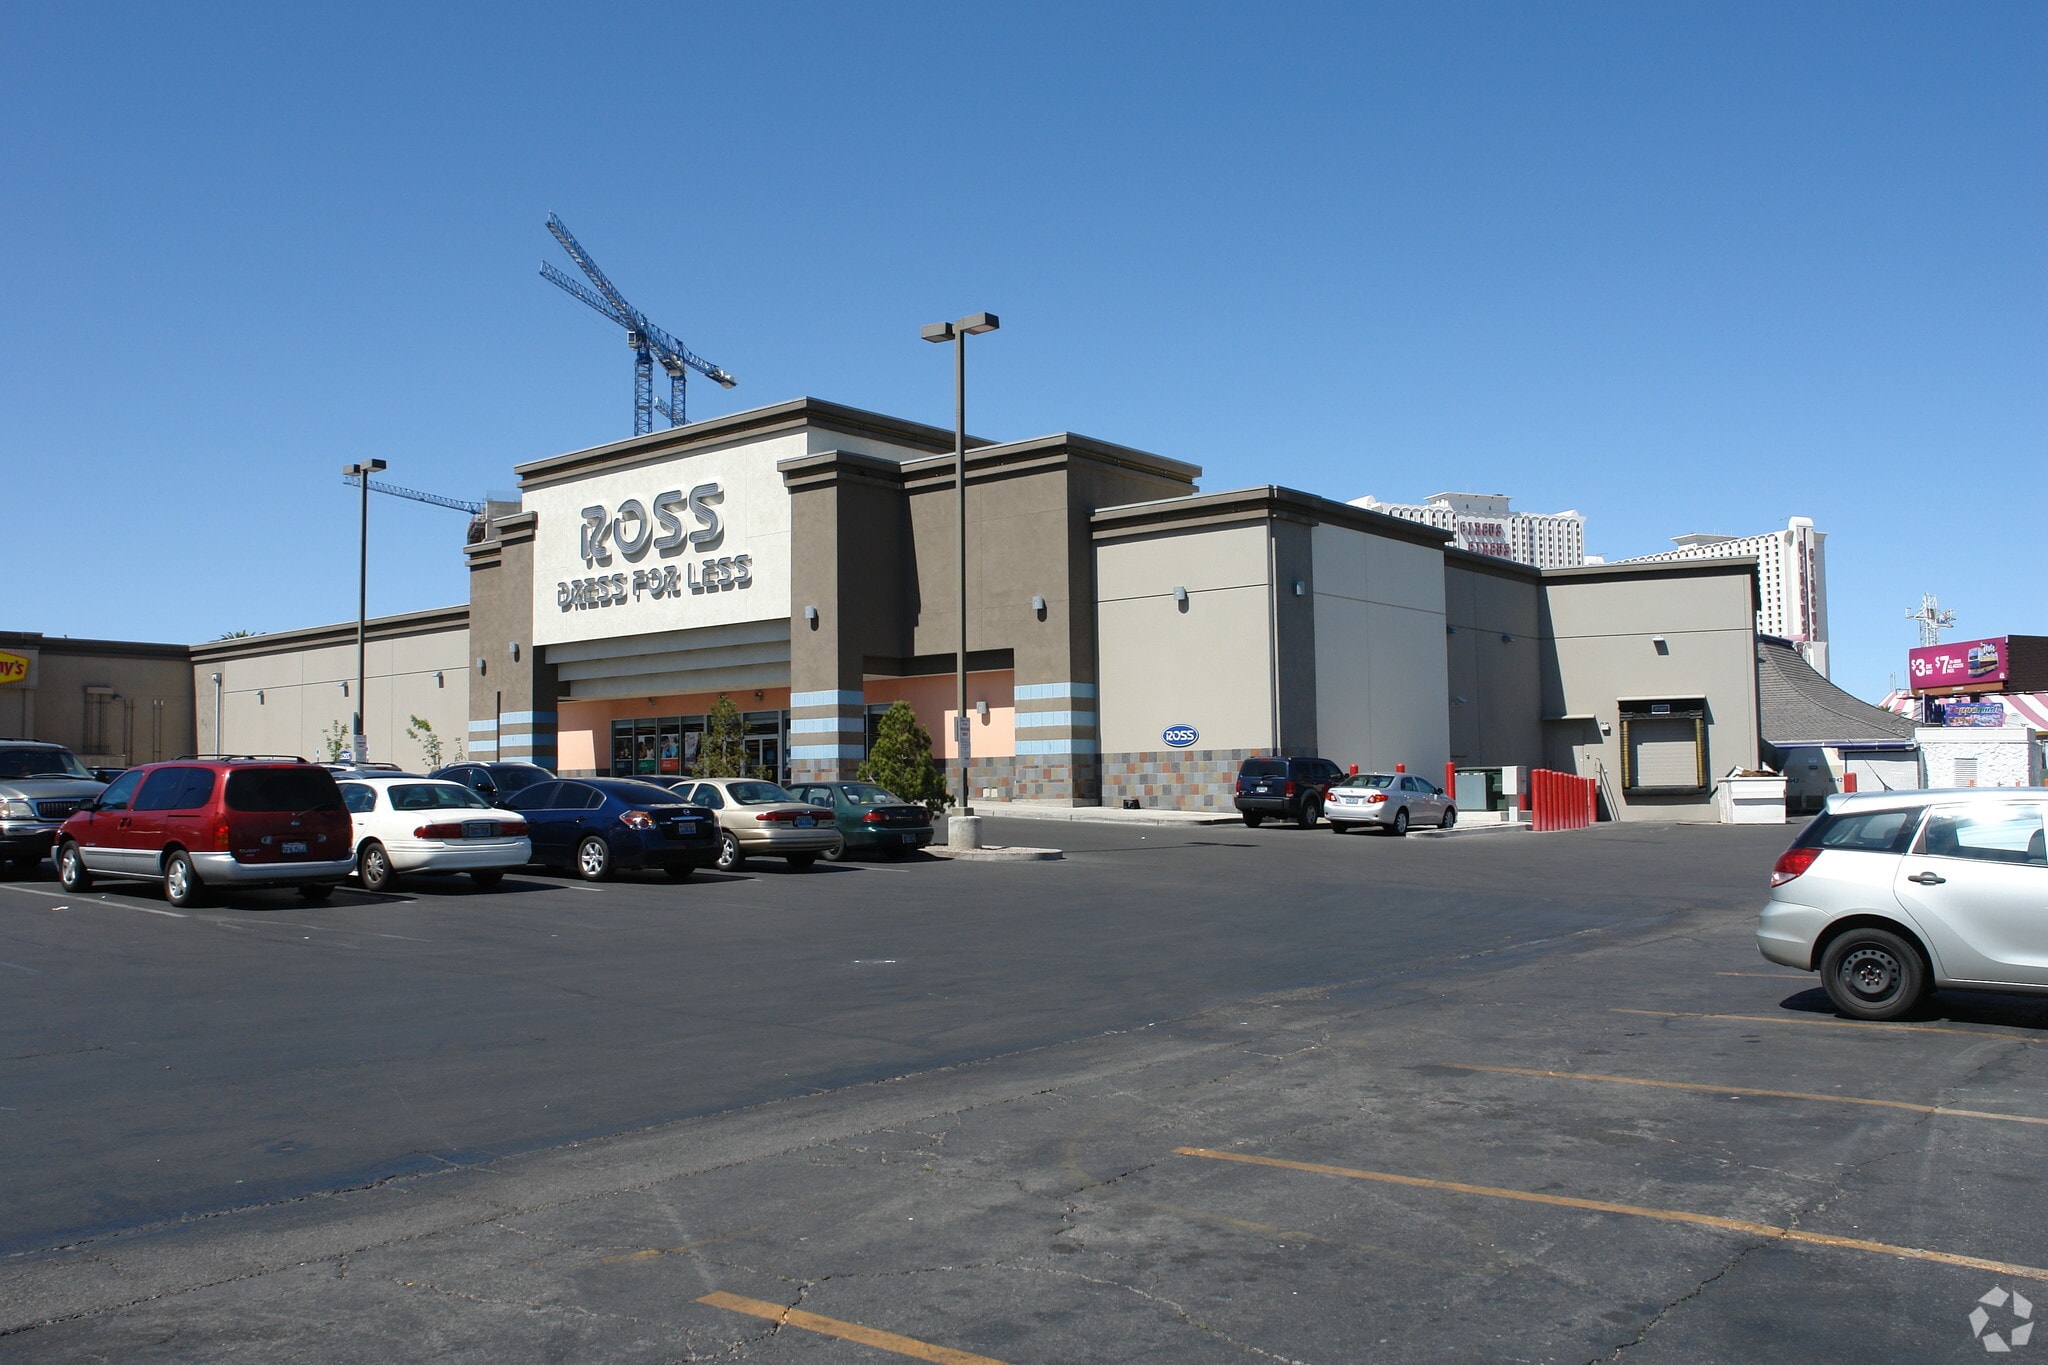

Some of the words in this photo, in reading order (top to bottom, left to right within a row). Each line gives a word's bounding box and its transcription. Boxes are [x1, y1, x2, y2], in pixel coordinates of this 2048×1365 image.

[581, 482, 723, 564] ROSS
[1460, 521, 1502, 537] CIRCUS
[1468, 541, 1509, 556] CIRCUS
[558, 573, 628, 610] DRESS
[633, 565, 681, 600] FOR
[688, 554, 752, 593] LESS
[1798, 540, 1807, 635] CIRCUS
[1809, 548, 1817, 641] CIRCUS
[1911, 658, 1926, 677] $3
[1934, 655, 1950, 675] $7
[1166, 730, 1195, 741] ROSS
